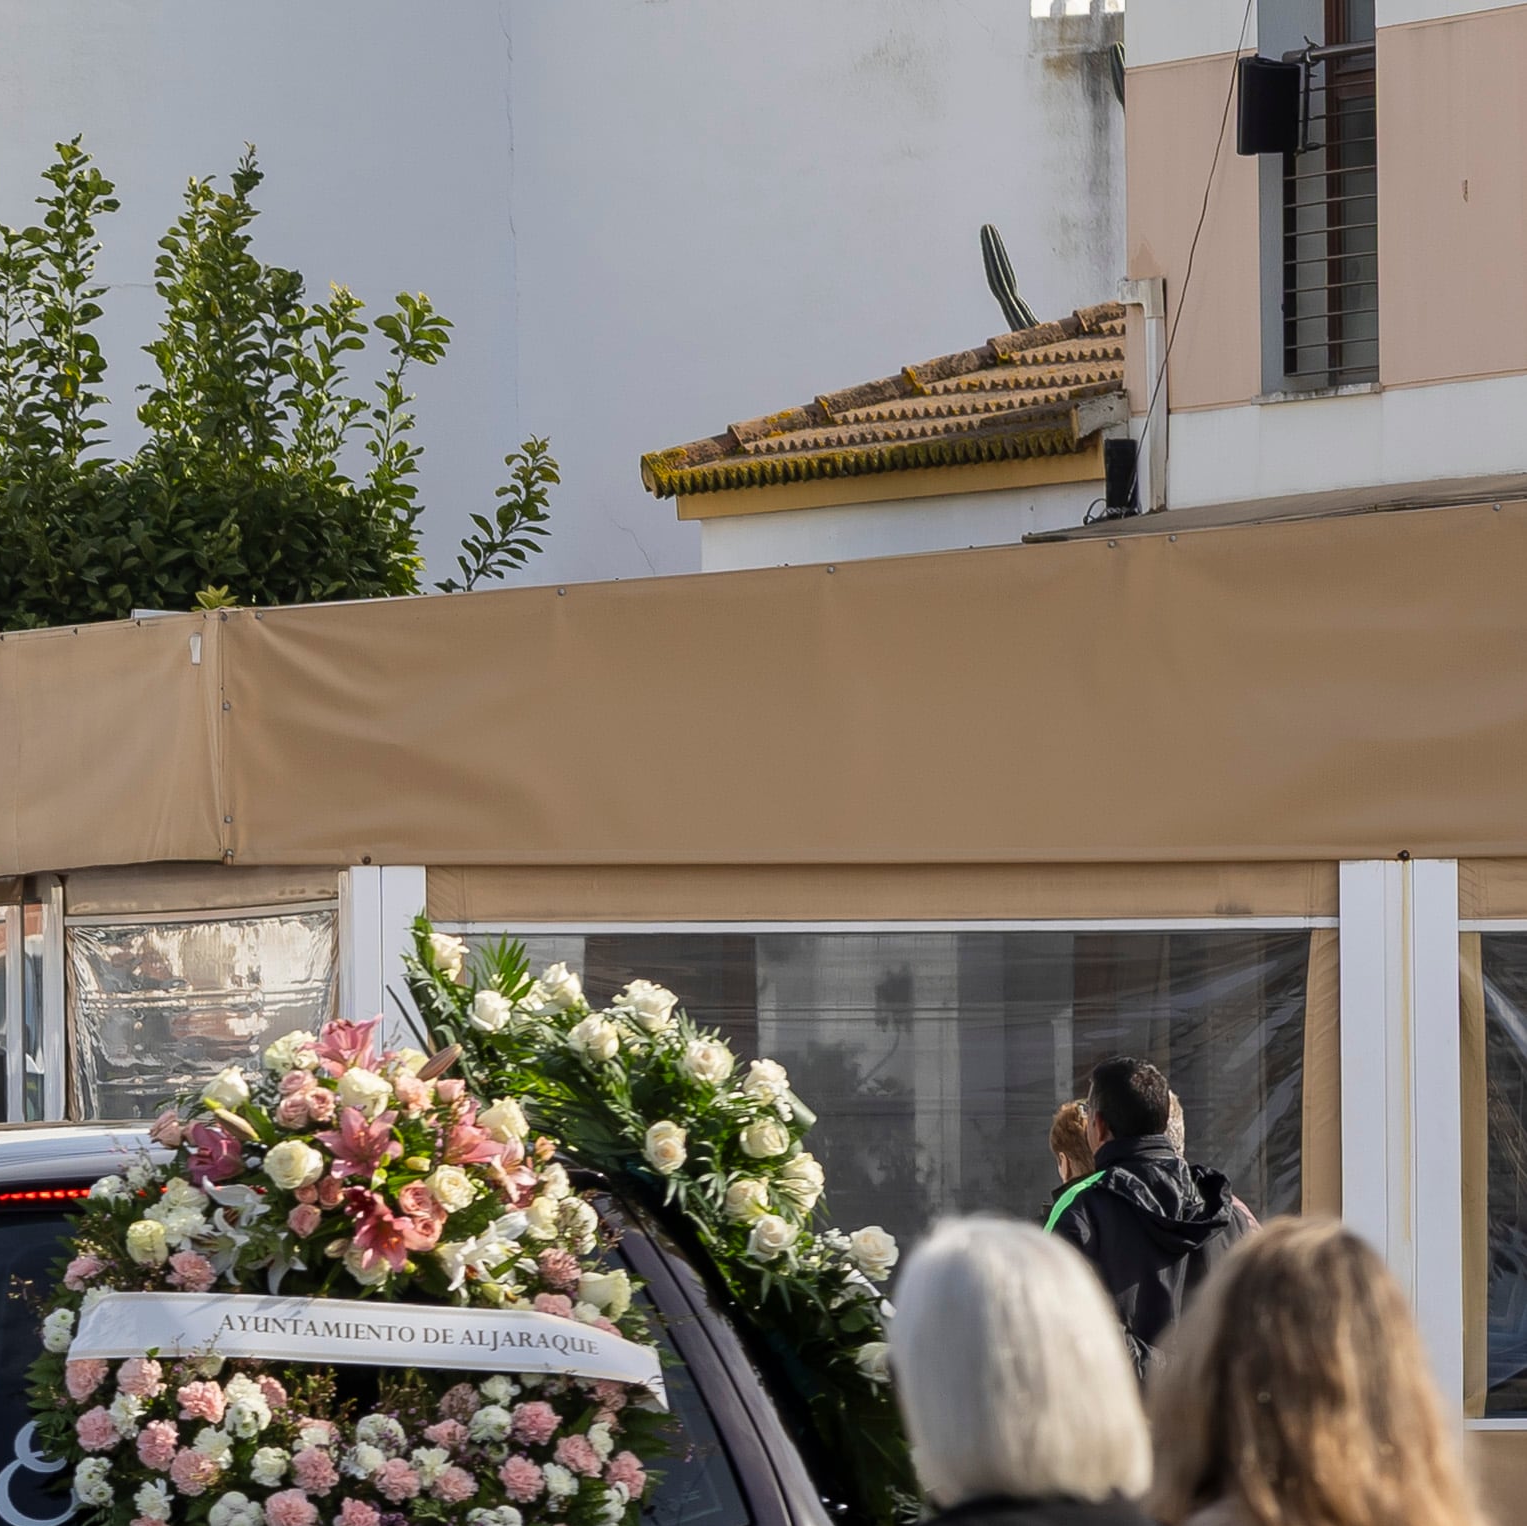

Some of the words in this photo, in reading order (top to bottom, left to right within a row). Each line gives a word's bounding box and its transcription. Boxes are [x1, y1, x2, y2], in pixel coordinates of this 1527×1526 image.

[219, 1314, 415, 1343] AYUNTAMIENTO
[422, 1327, 454, 1345] DE
[460, 1329, 600, 1356] ALJARAQUE
